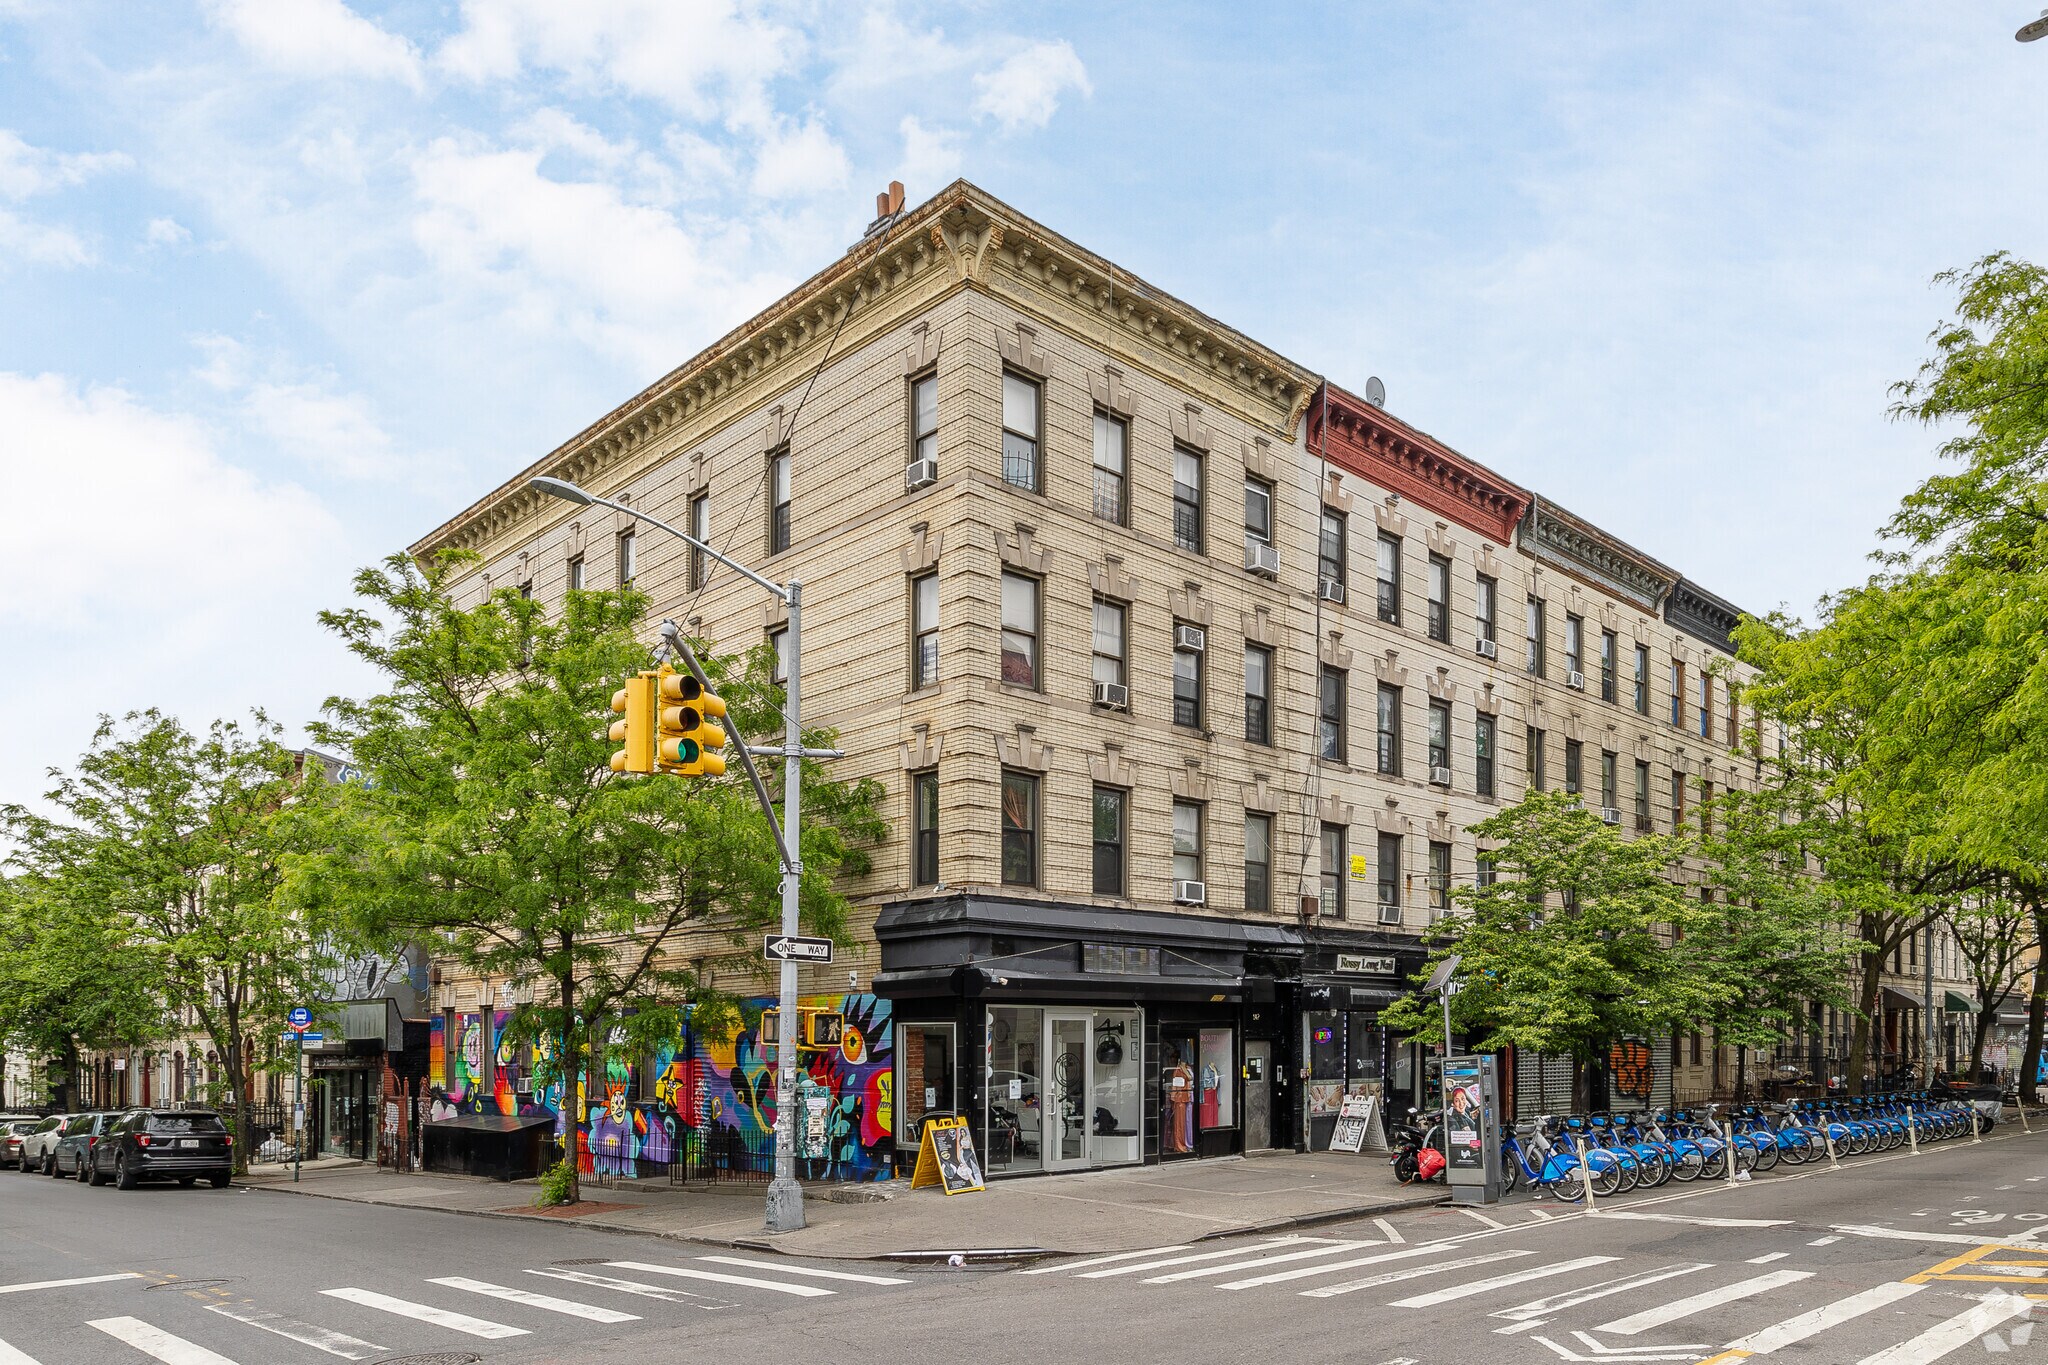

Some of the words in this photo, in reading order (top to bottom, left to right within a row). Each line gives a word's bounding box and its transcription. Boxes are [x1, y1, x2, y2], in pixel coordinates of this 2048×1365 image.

[777, 943, 796, 953] ONE
[807, 945, 826, 955] WAY
[1361, 958, 1379, 971] Long
[1380, 959, 1394, 970] Nail
[1315, 1031, 1332, 1040] OPEN
